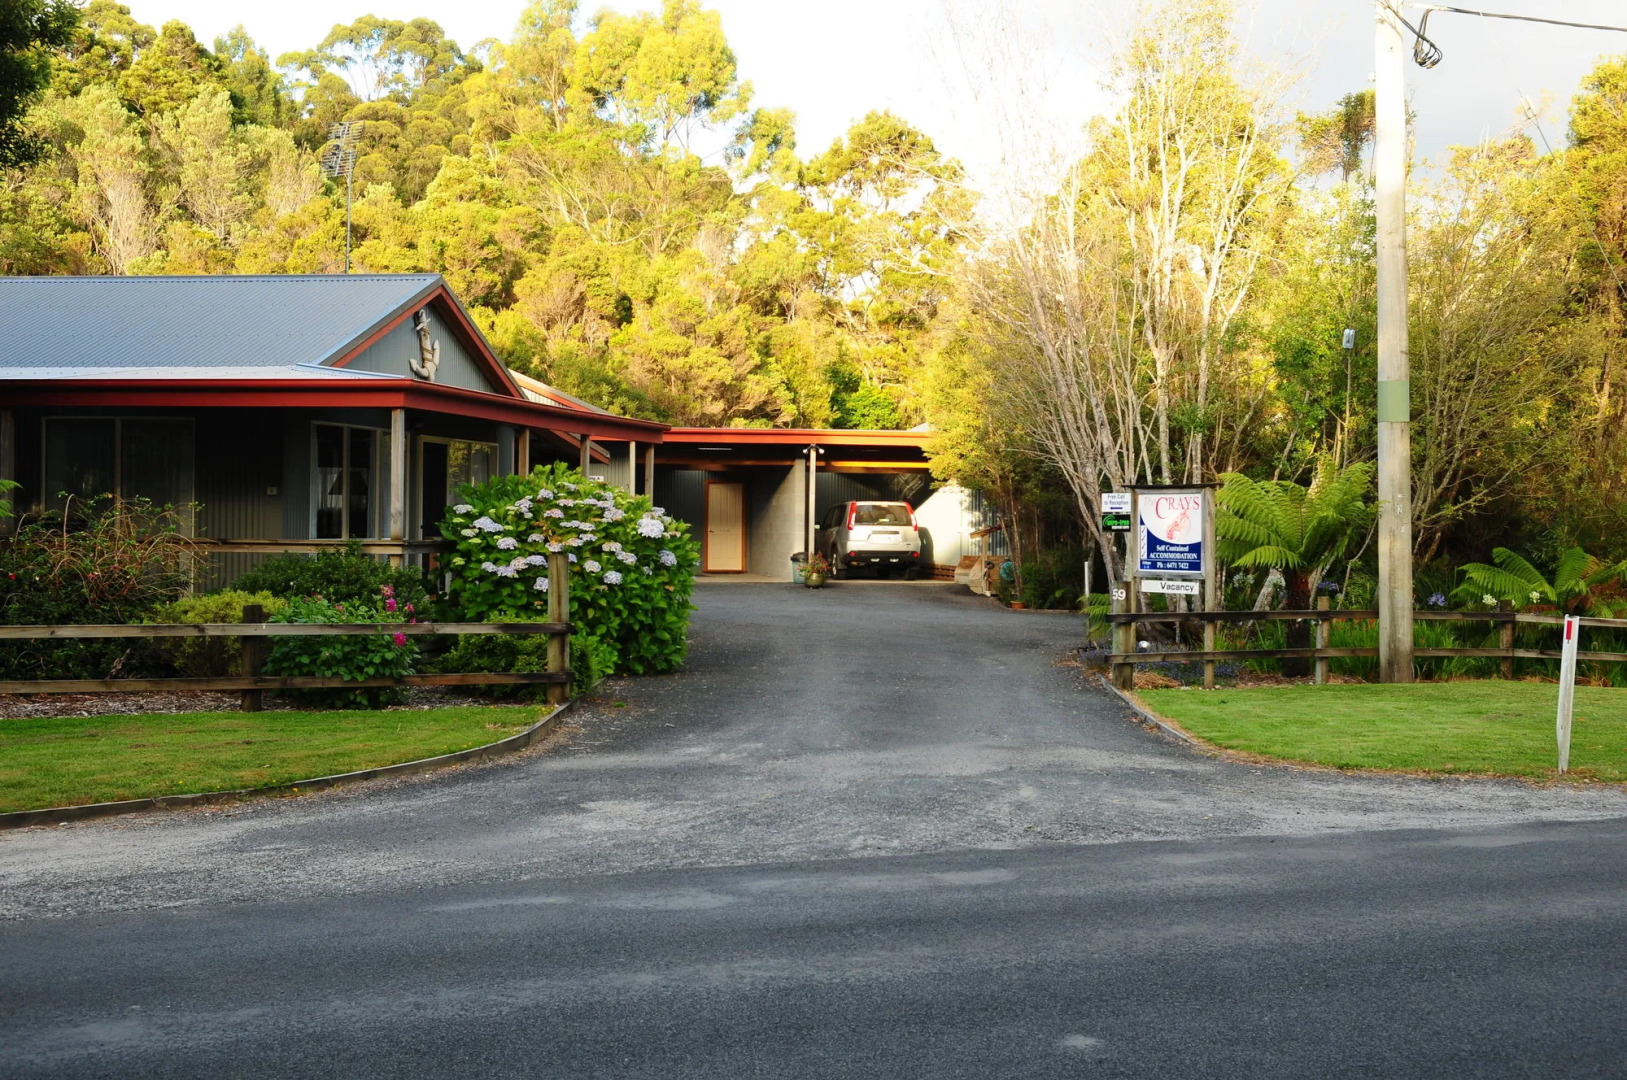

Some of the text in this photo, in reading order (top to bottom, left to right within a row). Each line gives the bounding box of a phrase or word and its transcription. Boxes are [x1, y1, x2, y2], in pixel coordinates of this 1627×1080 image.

[1155, 496, 1200, 519] CRAYS
[1149, 552, 1198, 560] ACCOMMODATION
[1160, 582, 1195, 593] Vacancy
[1112, 589, 1126, 600] 59
